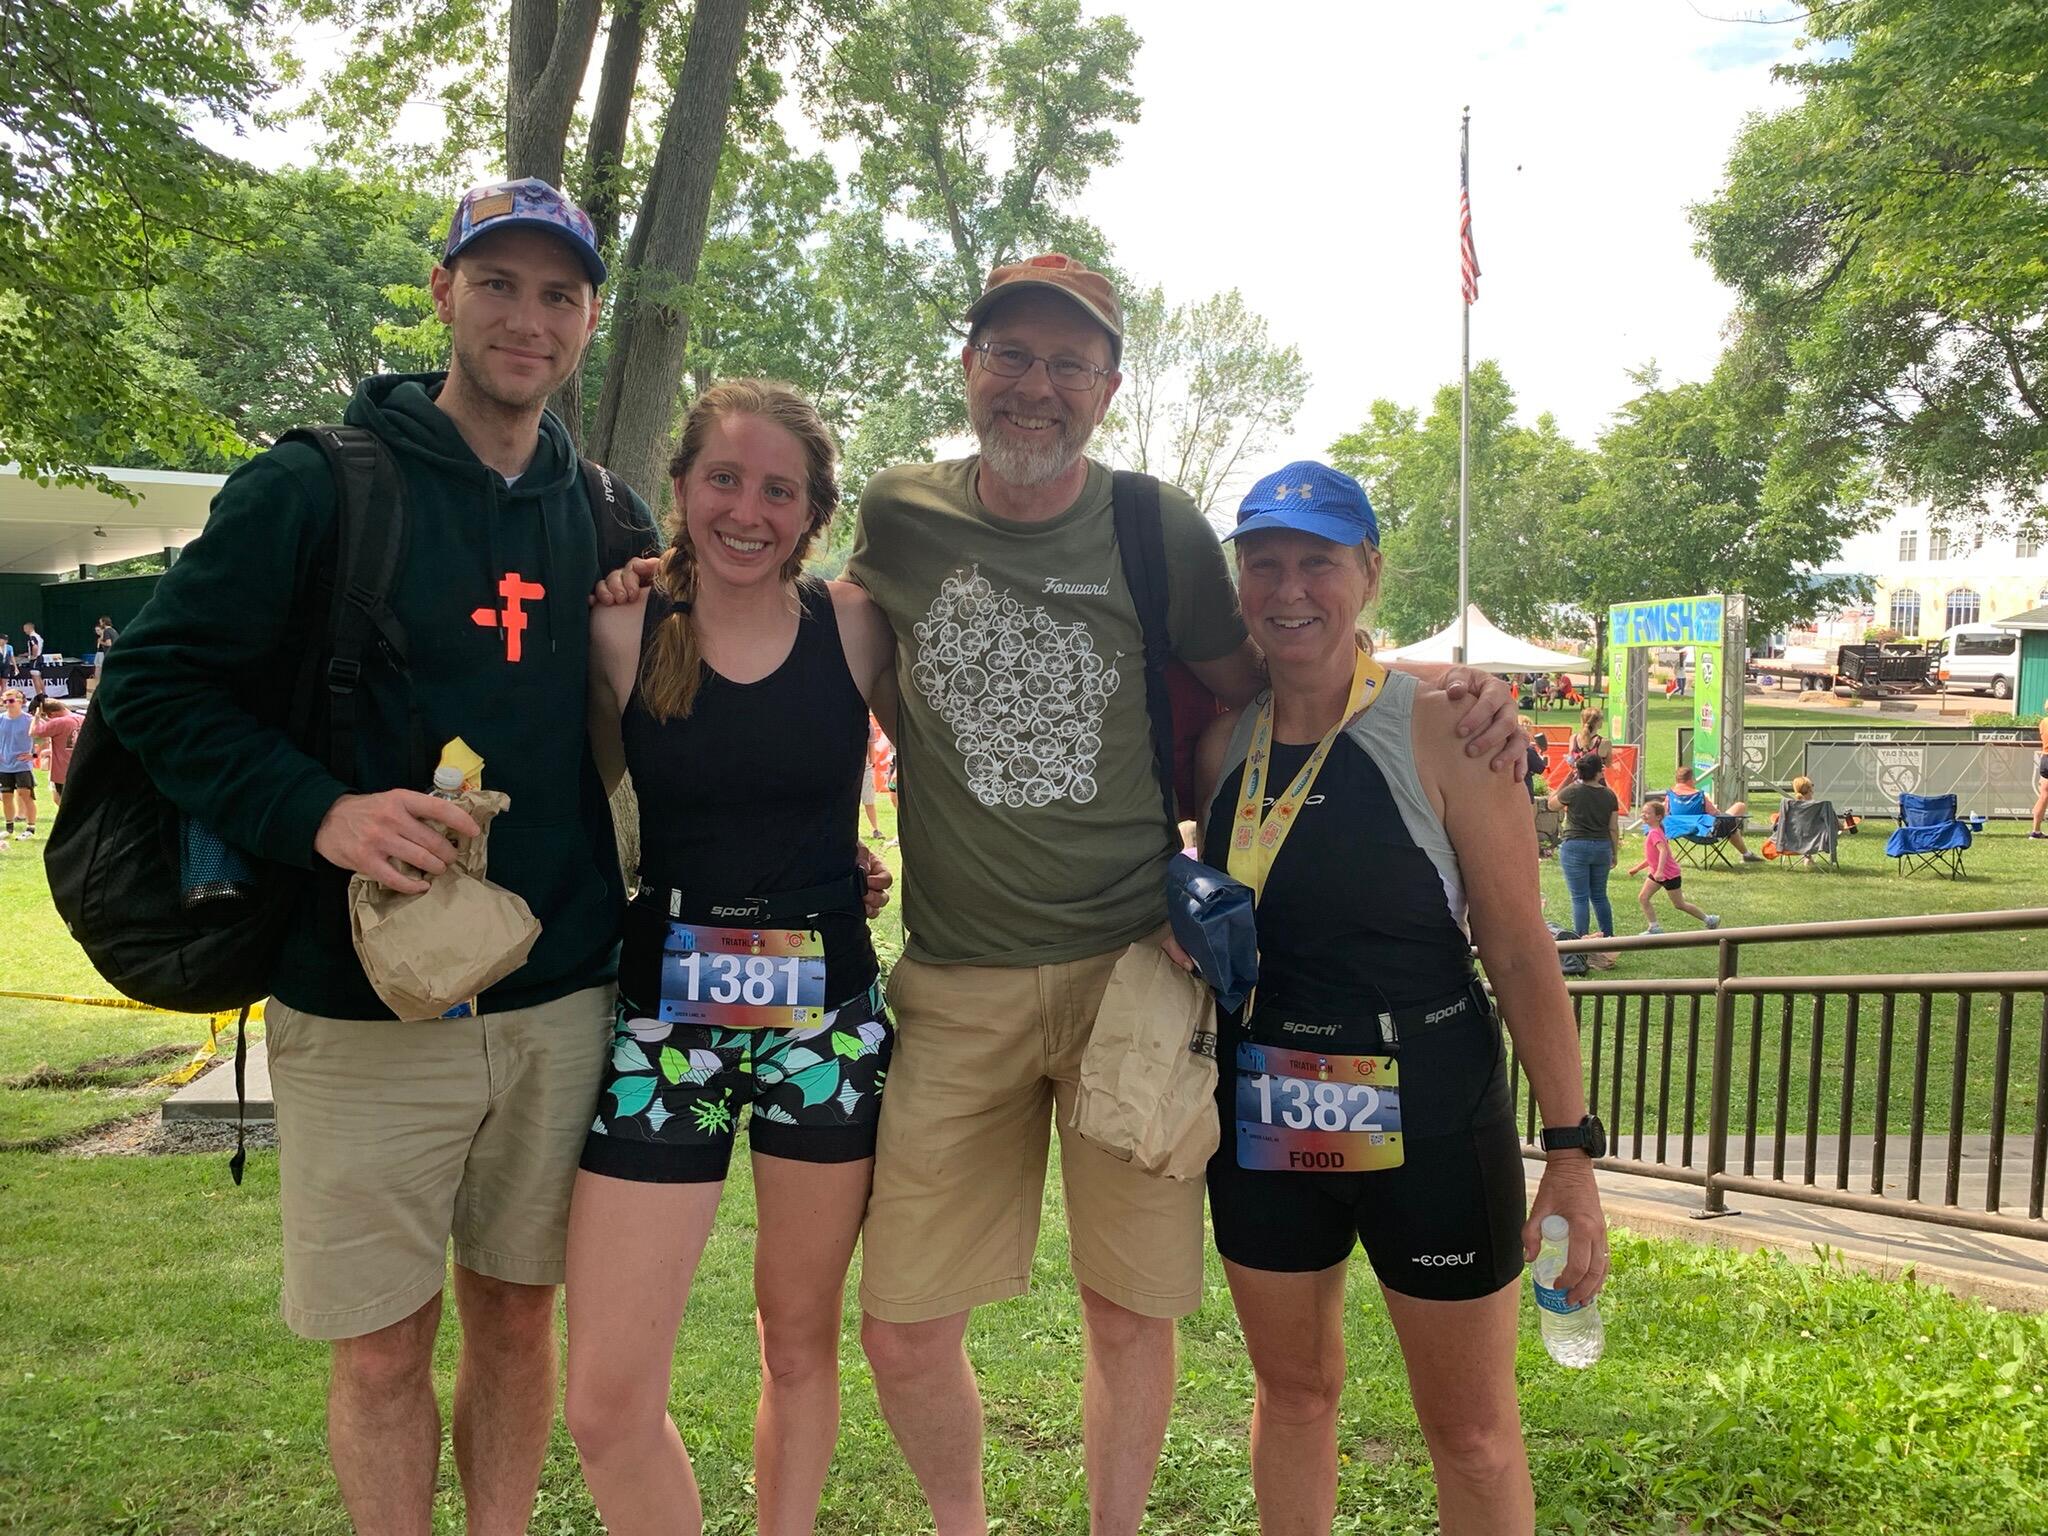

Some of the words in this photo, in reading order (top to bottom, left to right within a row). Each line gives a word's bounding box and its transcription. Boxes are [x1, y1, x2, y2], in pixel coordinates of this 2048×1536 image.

[1041, 576, 1111, 596] Forward
[1633, 602, 1694, 643] FINISH
[680, 952, 800, 1006] 1381
[1424, 999, 1467, 1024] sporti
[1282, 1021, 1338, 1036] sporti
[1251, 1074, 1383, 1132] 1382
[1289, 1151, 1345, 1168] FOOD
[1420, 1251, 1476, 1266] coeur
